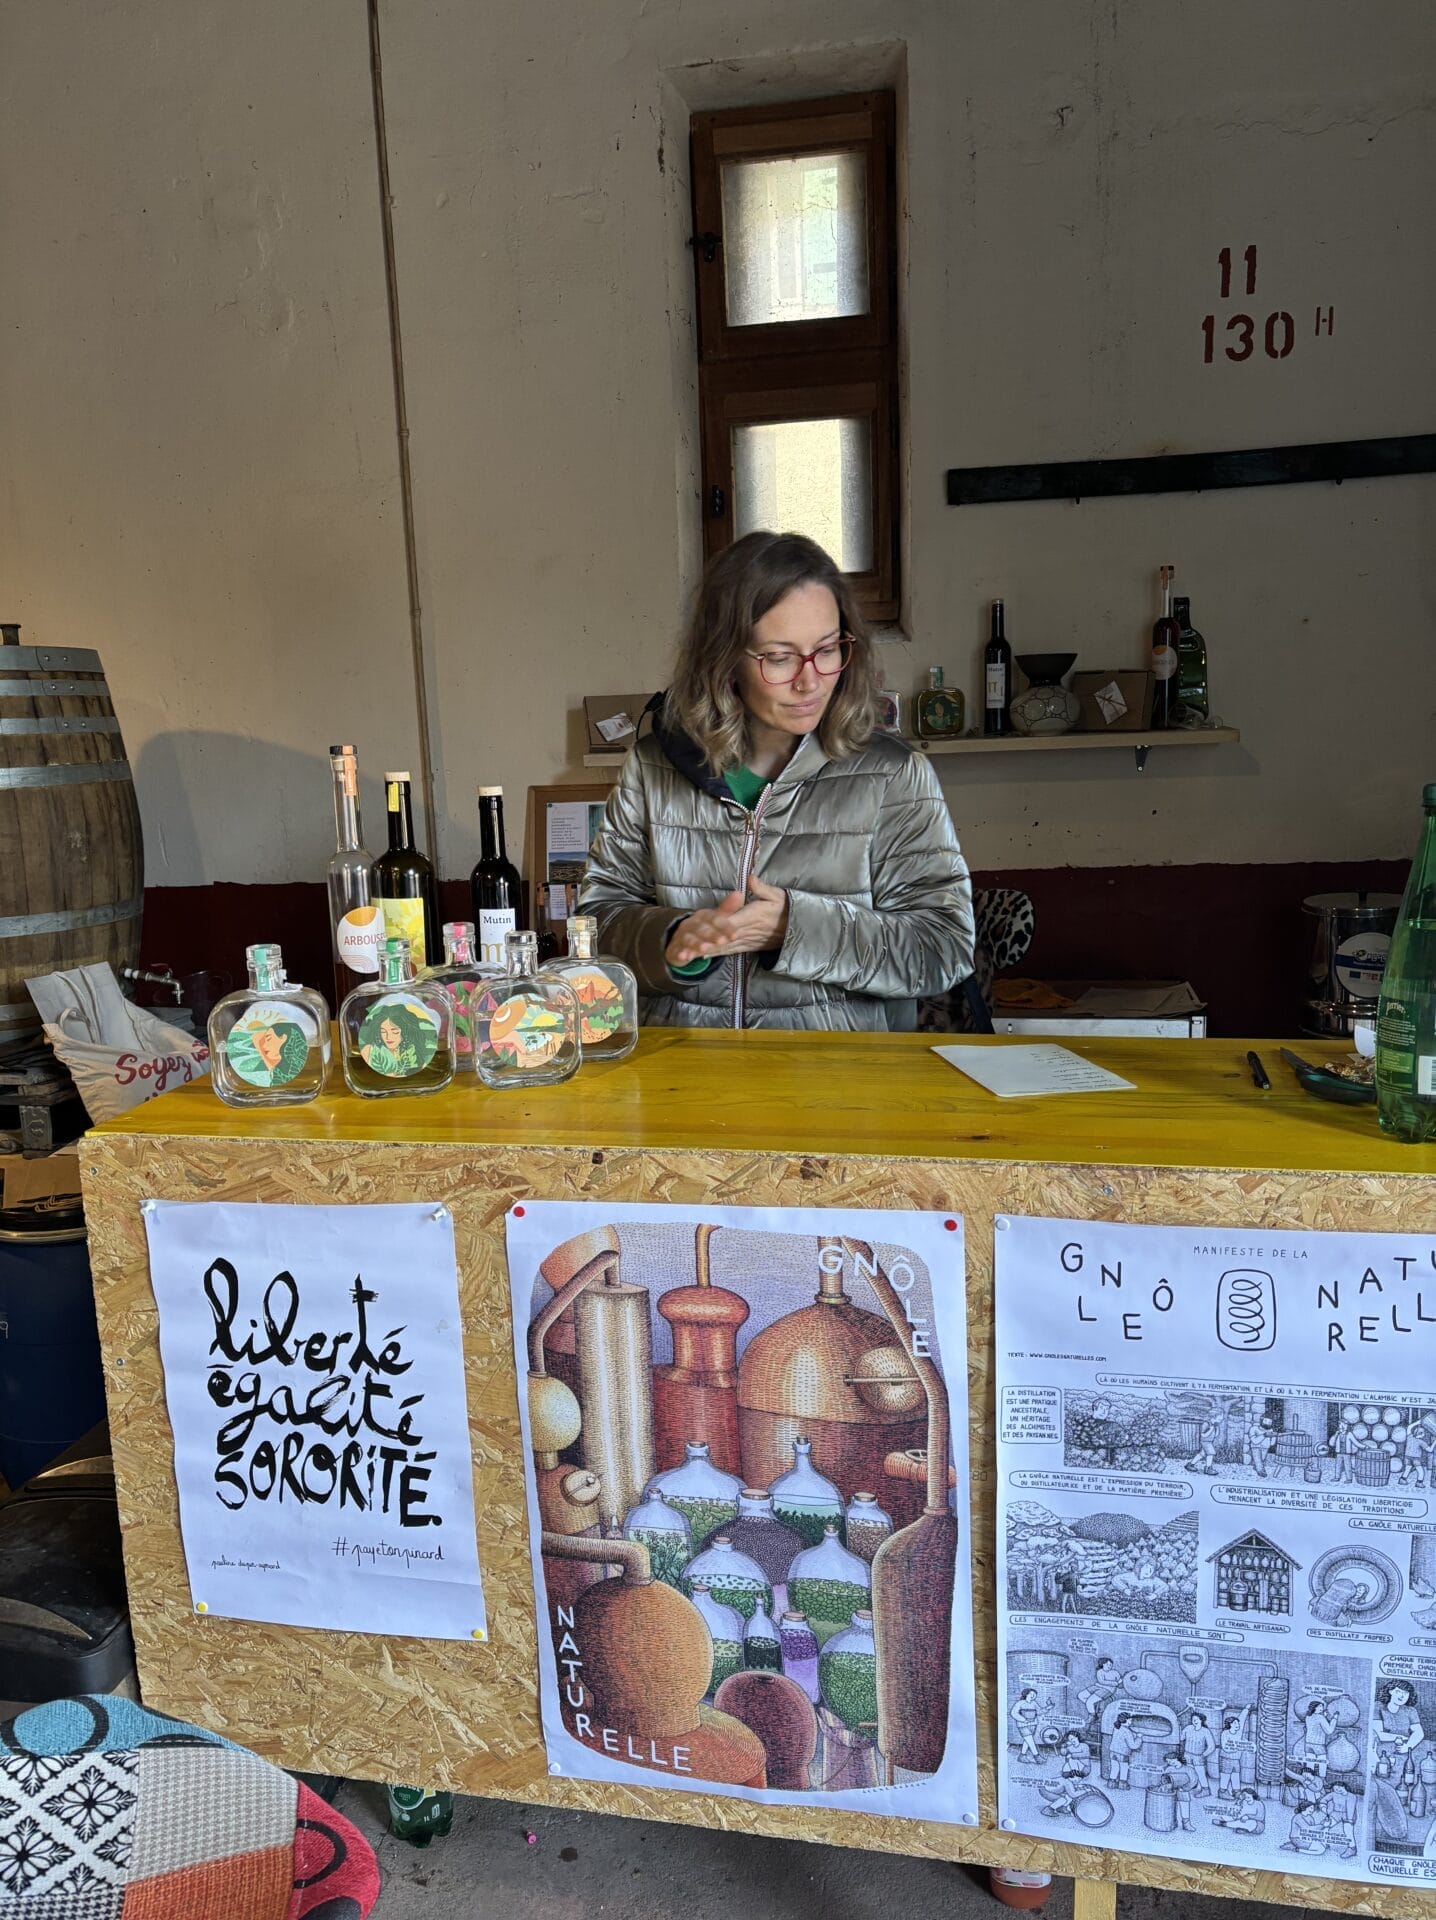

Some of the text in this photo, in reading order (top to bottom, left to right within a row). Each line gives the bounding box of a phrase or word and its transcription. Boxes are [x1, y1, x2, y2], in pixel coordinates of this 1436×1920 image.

[1218, 245, 1257, 298] 11
[1202, 306, 1334, 363] 130 H
[483, 915, 512, 924] Mutin
[115, 1053, 193, 1091] Soyez
[1193, 1246, 1308, 1259] MANIFESTE DE LA
[203, 1257, 414, 1375] liberté
[1311, 1390, 1360, 1399] FERMENTATION
[1363, 1393, 1398, 1402] L'ALAMBIC
[1401, 1396, 1422, 1404] N'EST
[207, 1364, 425, 1455] égalité
[1101, 1477, 1142, 1486] L'EXPRESSION
[1119, 1487, 1147, 1495] MATIÈRE
[1218, 1486, 1286, 1497] L'INDUSTRIALISATION
[1321, 1494, 1367, 1504] LÉGISLATION
[1373, 1499, 1413, 1508] LIBERTICIDE
[1228, 1495, 1261, 1503] MENACENT
[1281, 1499, 1317, 1508] DIVERSITÉ
[1338, 1503, 1353, 1511] CES
[1368, 1520, 1392, 1529] GNÔLE
[331, 1536, 446, 1569] #payetonpinard
[1034, 1617, 1084, 1627] ENGAGEMENTS
[1108, 1622, 1118, 1630] LA
[1125, 1623, 1149, 1632] GNÔLE
[1156, 1626, 1200, 1637] NATURELLE
[1228, 1621, 1250, 1629] TRAVAIL
[1253, 1624, 1288, 1633] ARTISANAL
[1325, 1631, 1359, 1639] DISTILLATS
[1364, 1634, 1391, 1642] PROPRES
[1373, 1856, 1406, 1867] CHAQUE
[1373, 1864, 1419, 1876] NATURELLE
